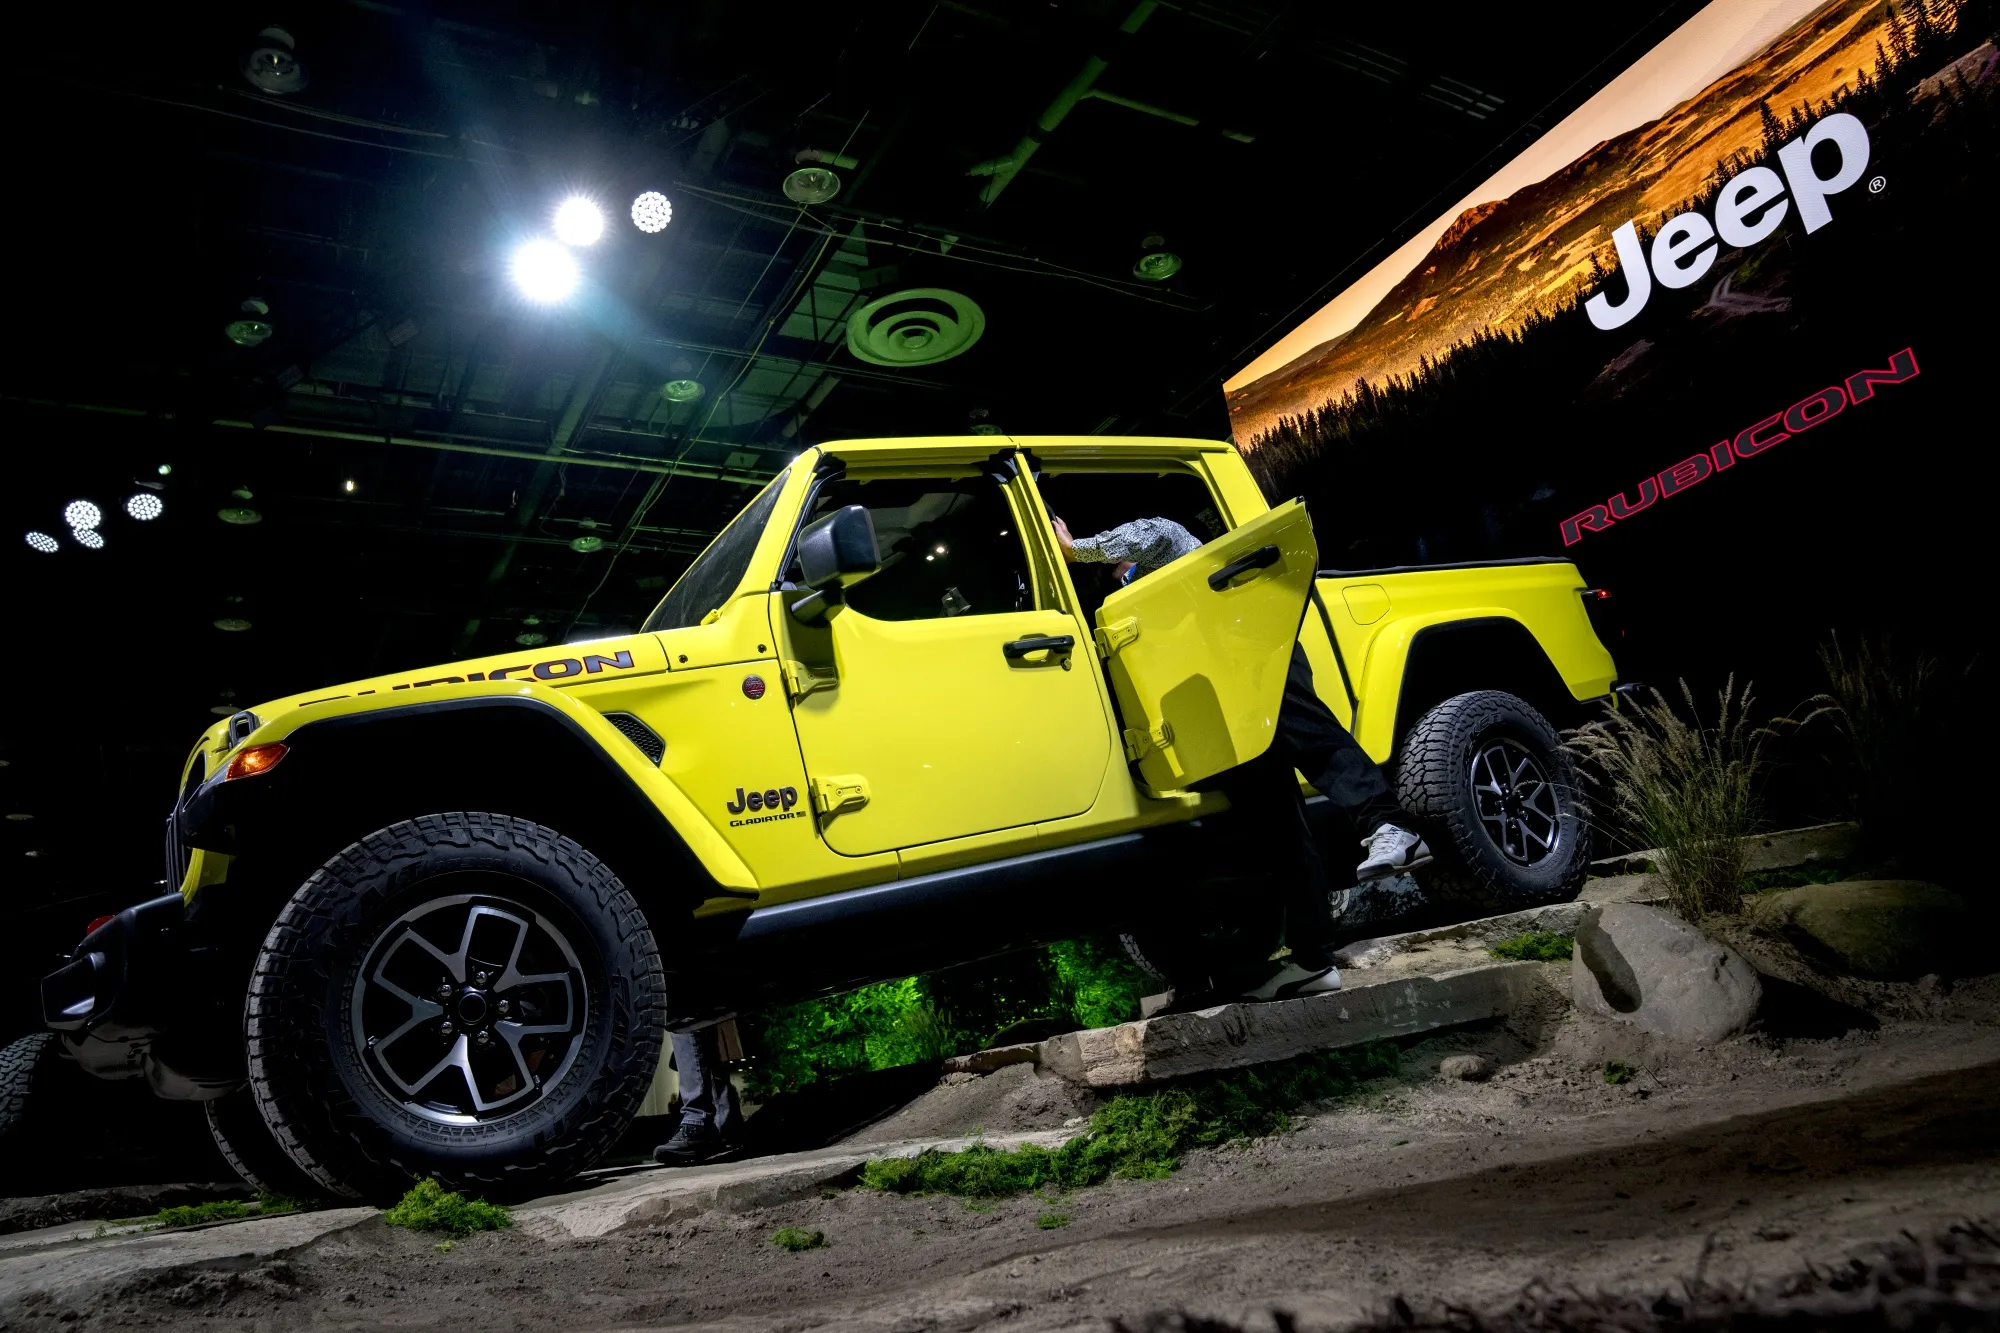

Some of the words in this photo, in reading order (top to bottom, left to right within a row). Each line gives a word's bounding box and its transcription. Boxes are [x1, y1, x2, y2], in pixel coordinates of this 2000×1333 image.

[1584, 112, 1871, 331] Jeep
[1560, 347, 1920, 547] RUBICON
[727, 786, 798, 815] Jeep
[729, 812, 796, 827] GLADIATOR
